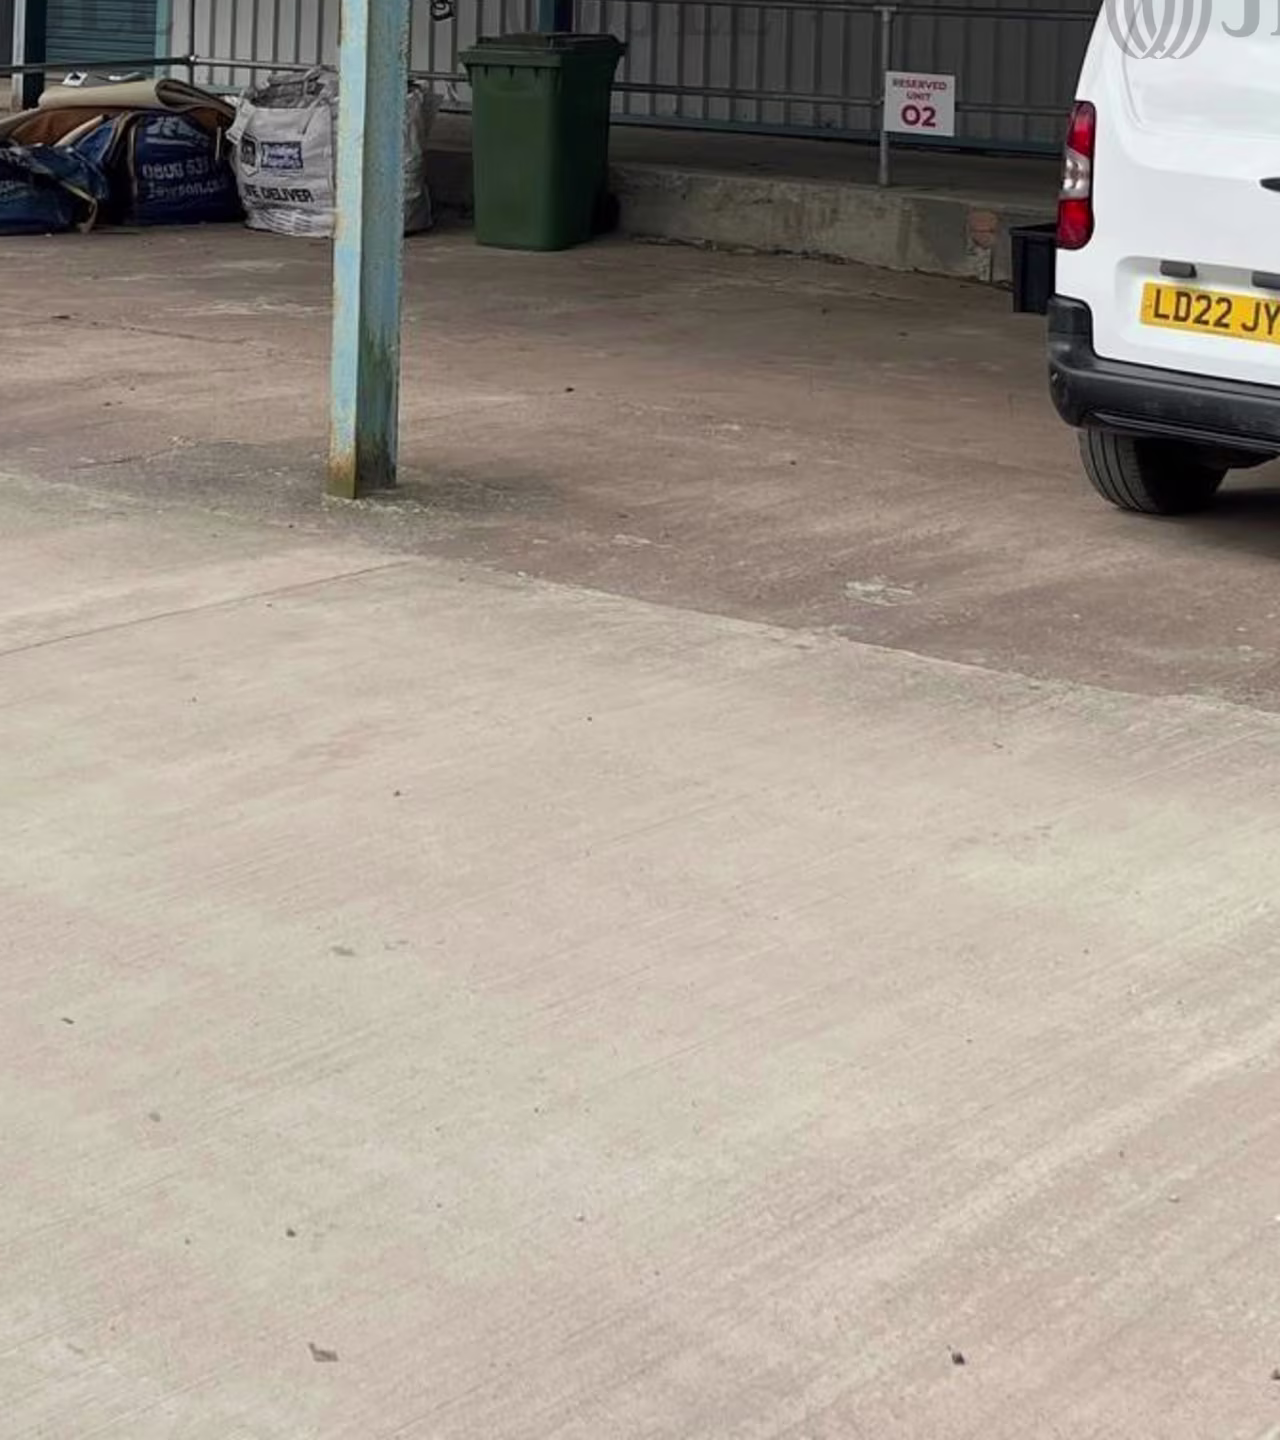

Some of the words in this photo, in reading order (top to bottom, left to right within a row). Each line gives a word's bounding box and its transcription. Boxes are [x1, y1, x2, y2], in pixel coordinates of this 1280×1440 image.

[892, 78, 947, 90] RESERVED
[902, 104, 936, 128] 02
[261, 187, 315, 203] DELIVER
[1153, 288, 1232, 329] LD22
